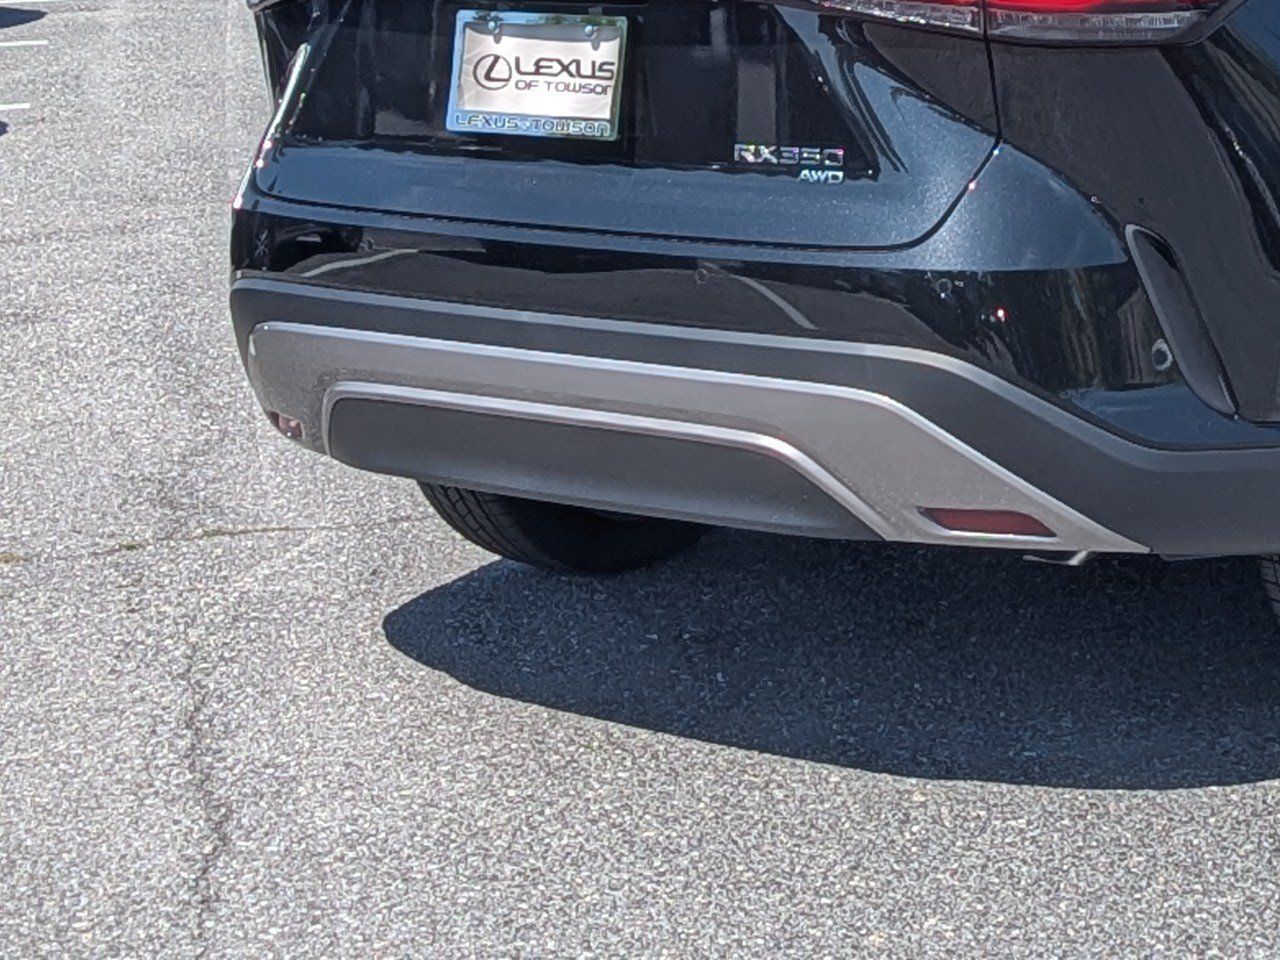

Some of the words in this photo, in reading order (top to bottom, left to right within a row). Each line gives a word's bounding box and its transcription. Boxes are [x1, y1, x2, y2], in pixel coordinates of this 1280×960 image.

[514, 56, 616, 81] LEXUS
[514, 79, 540, 91] OF
[799, 168, 844, 184] AWD
